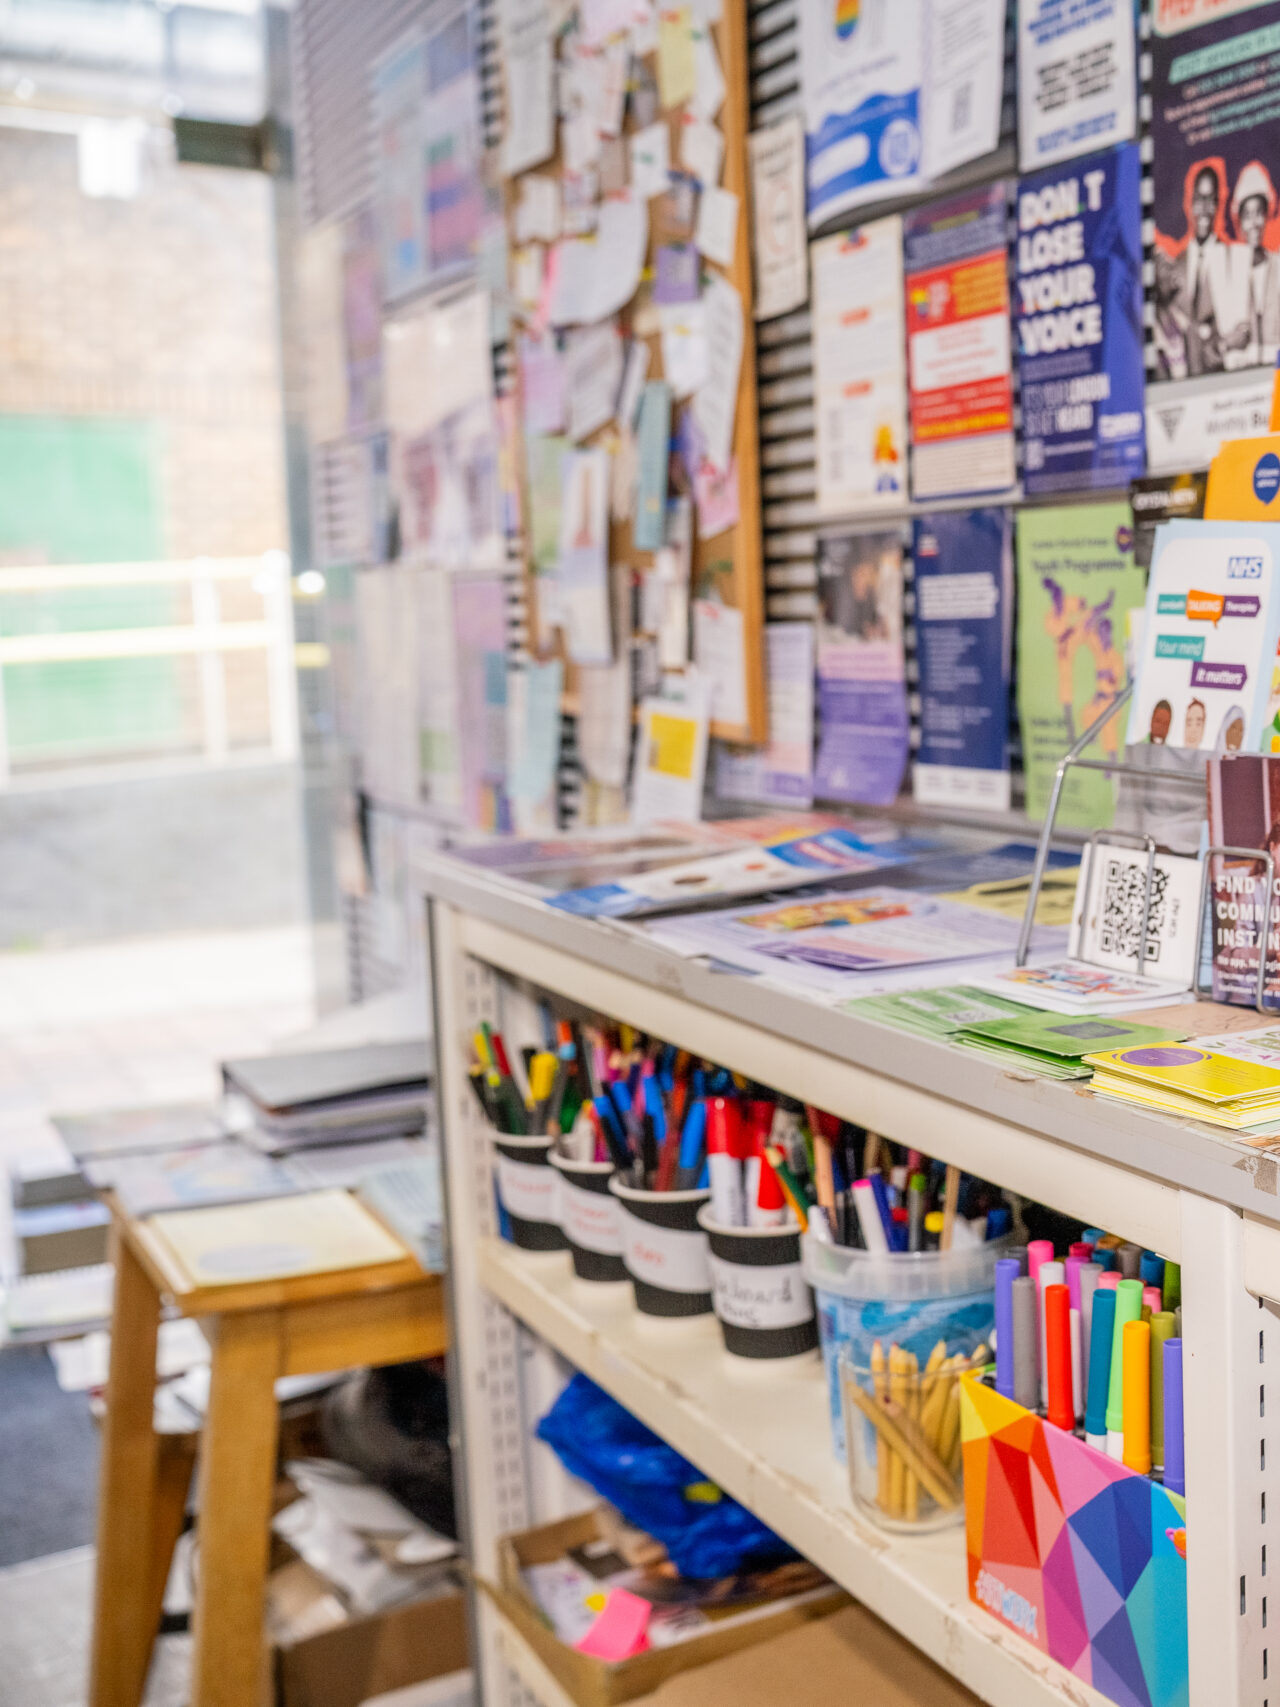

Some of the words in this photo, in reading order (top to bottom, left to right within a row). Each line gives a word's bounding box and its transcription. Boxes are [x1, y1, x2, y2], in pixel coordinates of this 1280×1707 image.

[1019, 168, 1106, 232] DONT
[1019, 219, 1085, 275] LOSE
[1017, 262, 1097, 317] YOUR
[1019, 303, 1103, 356] VOICE
[1216, 875, 1256, 894] FIND
